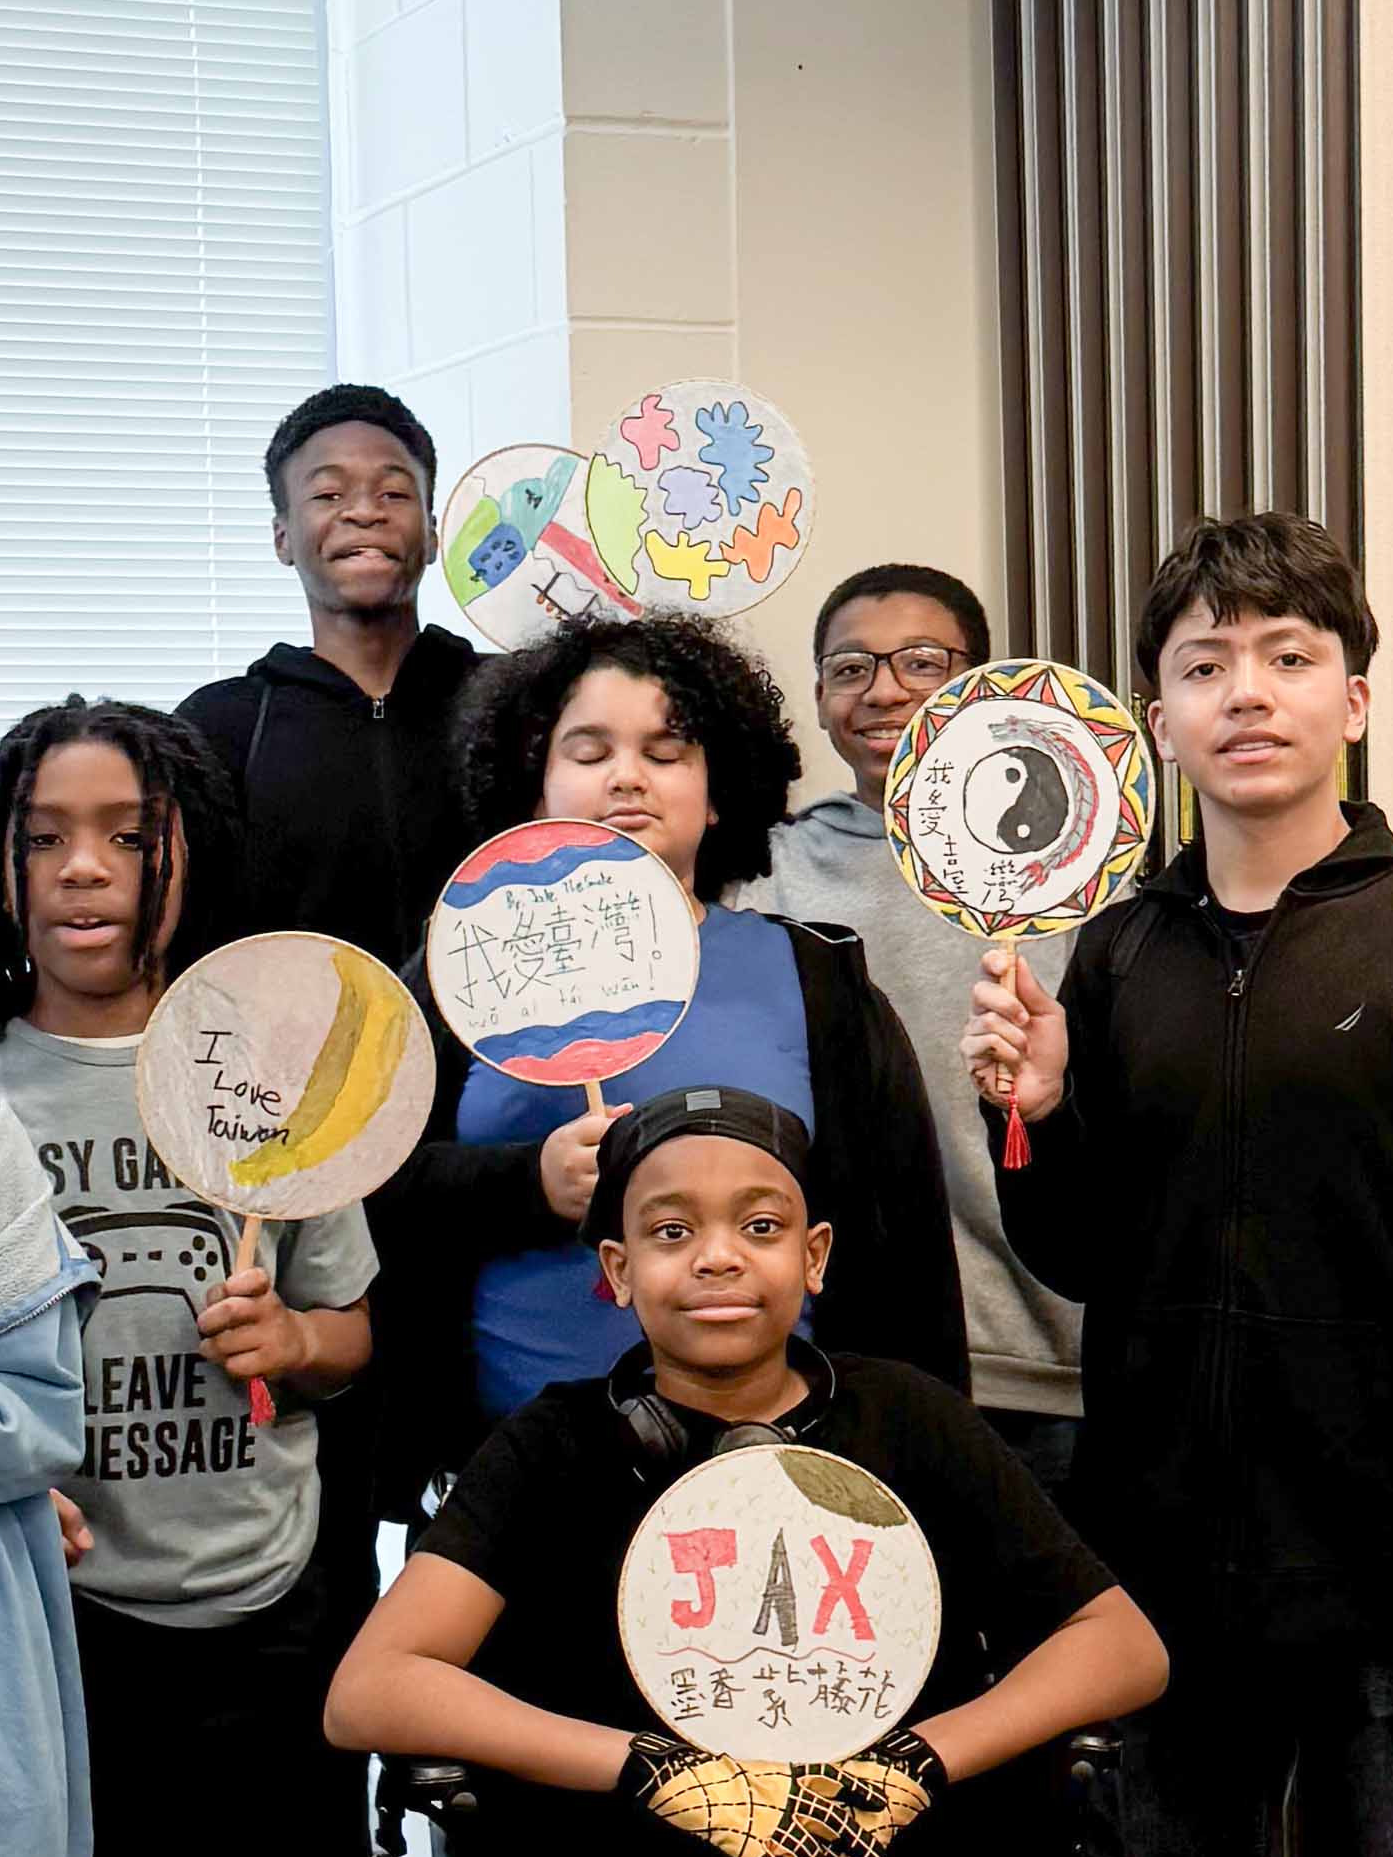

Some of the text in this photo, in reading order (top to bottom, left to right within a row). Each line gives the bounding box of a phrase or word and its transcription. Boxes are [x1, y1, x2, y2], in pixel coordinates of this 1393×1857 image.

[194, 1030, 233, 1065] I
[213, 1069, 282, 1117] Love
[207, 1104, 290, 1145] Taiwan
[40, 1140, 95, 1195] SY
[663, 1527, 876, 1647] JAX
